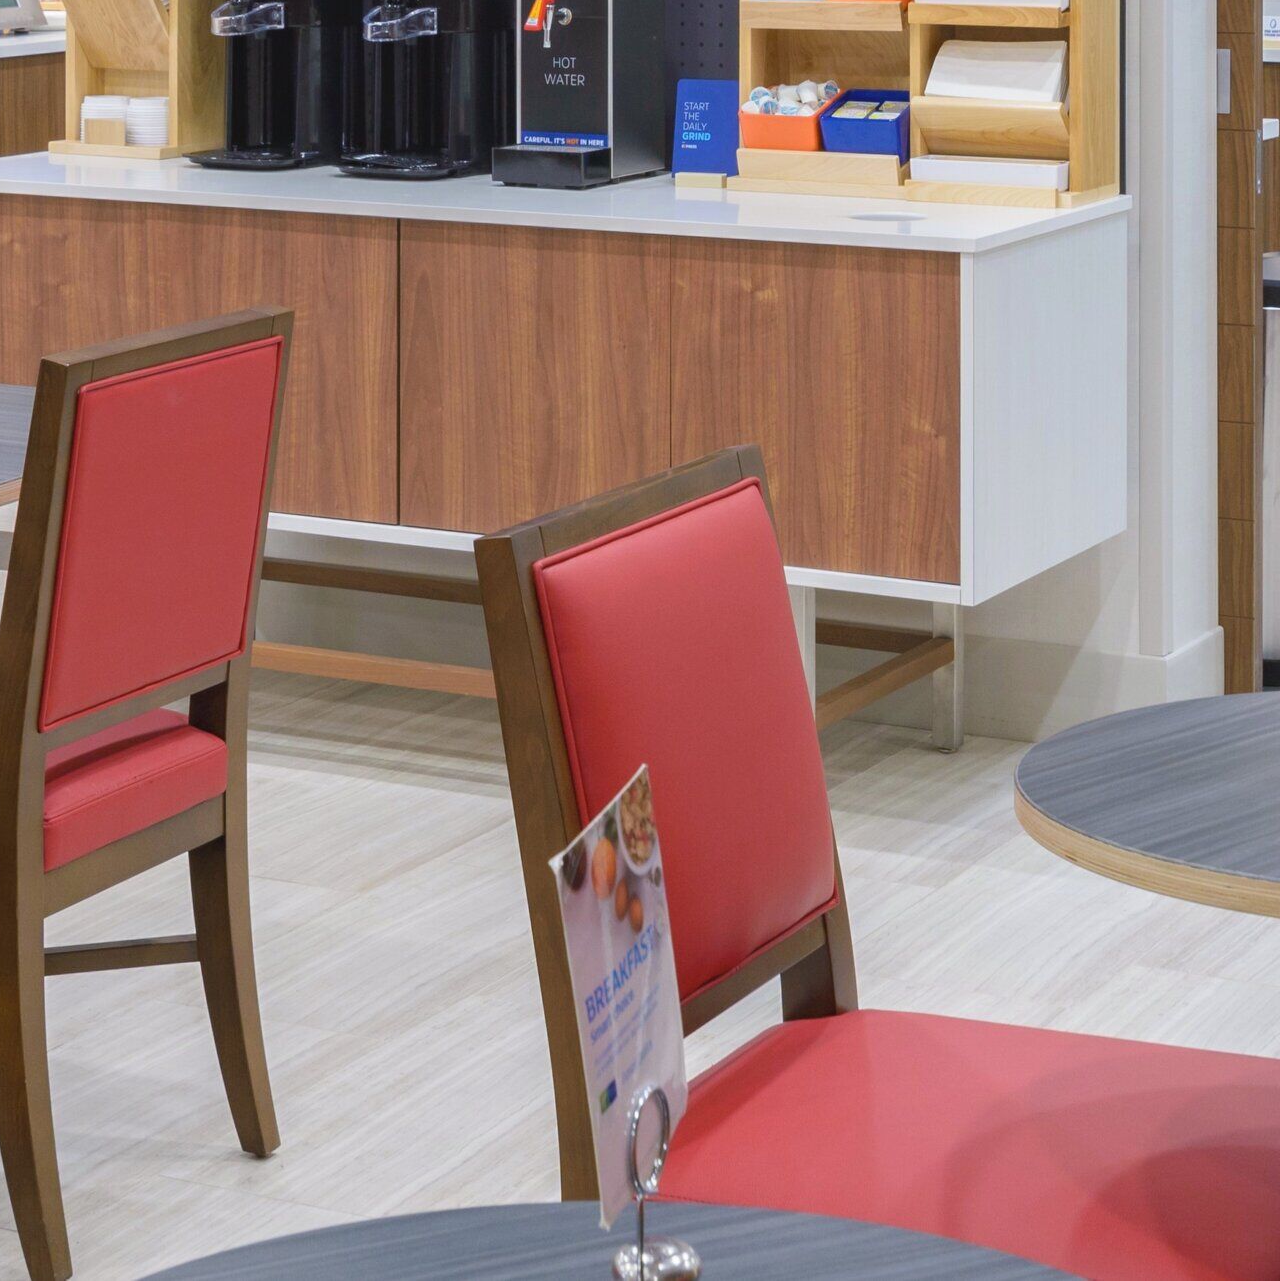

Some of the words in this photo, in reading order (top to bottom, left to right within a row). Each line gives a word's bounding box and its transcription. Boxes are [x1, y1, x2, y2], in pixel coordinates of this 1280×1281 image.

[553, 57, 576, 69] HOT
[544, 74, 585, 86] WATER
[684, 101, 710, 111] START
[683, 112, 700, 121] THE
[682, 122, 707, 131] DAILY
[682, 132, 711, 141] GRIND
[588, 139, 604, 147] HERE
[585, 923, 656, 1023] BREAKFAST
